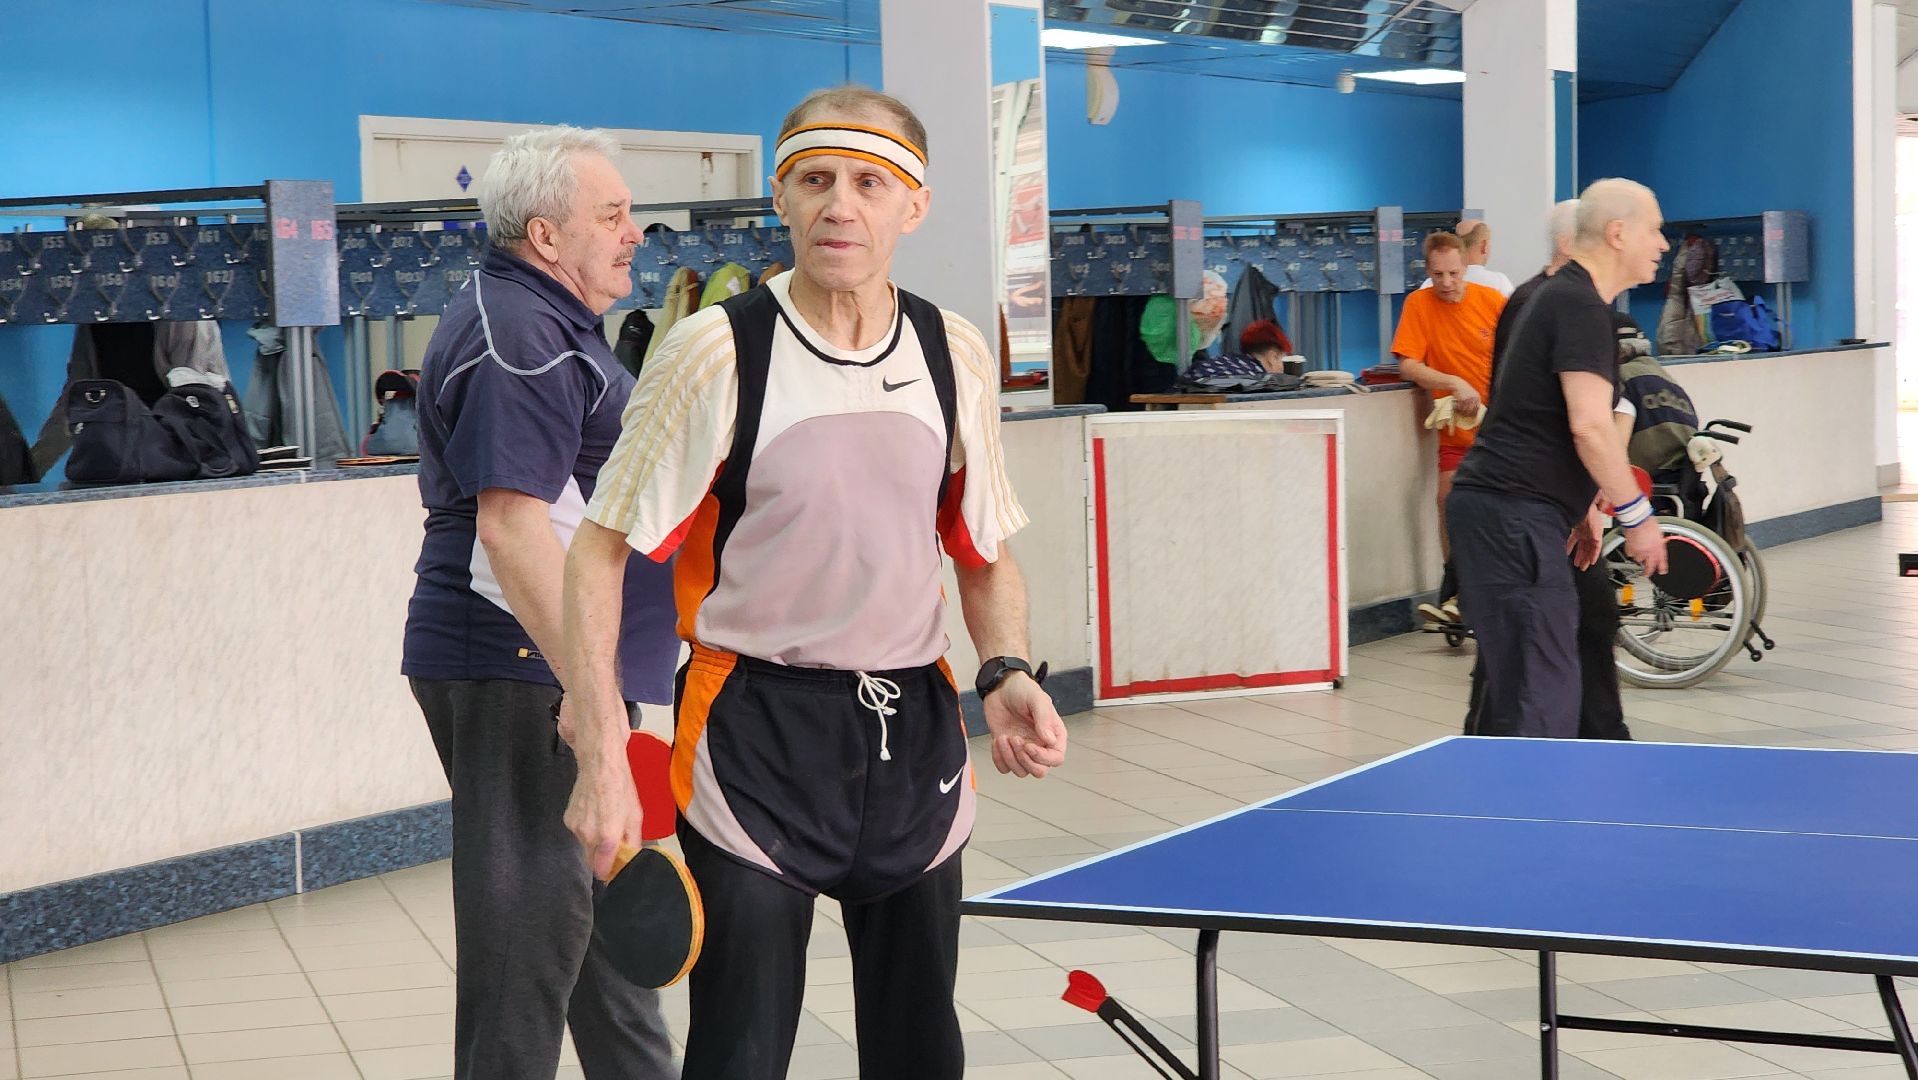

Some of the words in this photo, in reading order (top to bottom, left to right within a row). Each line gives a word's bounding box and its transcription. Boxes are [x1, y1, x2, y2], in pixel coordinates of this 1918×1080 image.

[43, 236, 65, 249] 155
[92, 235, 113, 247] 157
[145, 232, 169, 245] 159
[198, 230, 219, 243] 161
[439, 234, 463, 247] 204
[206, 270, 229, 284] 162
